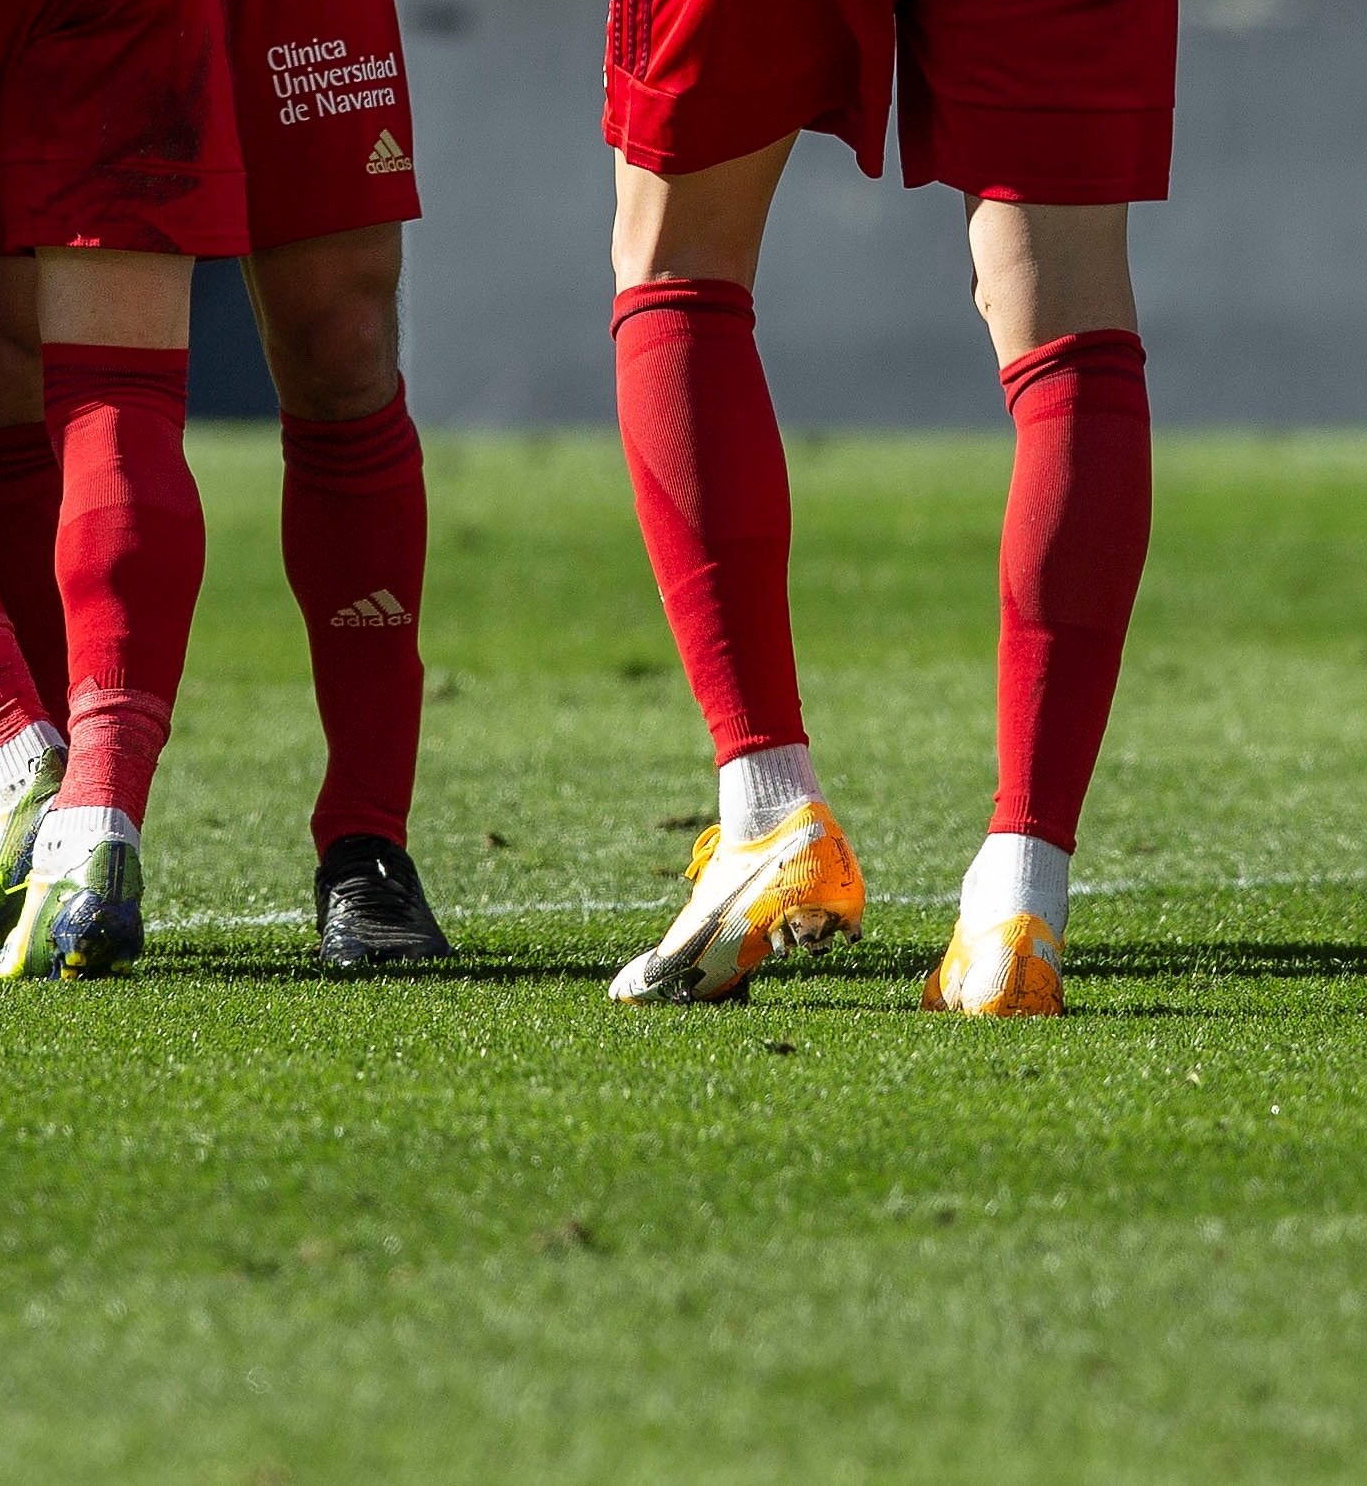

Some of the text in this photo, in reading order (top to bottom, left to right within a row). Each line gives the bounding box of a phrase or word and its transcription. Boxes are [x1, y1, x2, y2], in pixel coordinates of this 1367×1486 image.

[267, 38, 347, 71] Clínica
[272, 52, 398, 99] Universidad
[279, 87, 396, 125] de Navarra
[366, 156, 413, 175] adidas
[330, 613, 413, 627] adidas
